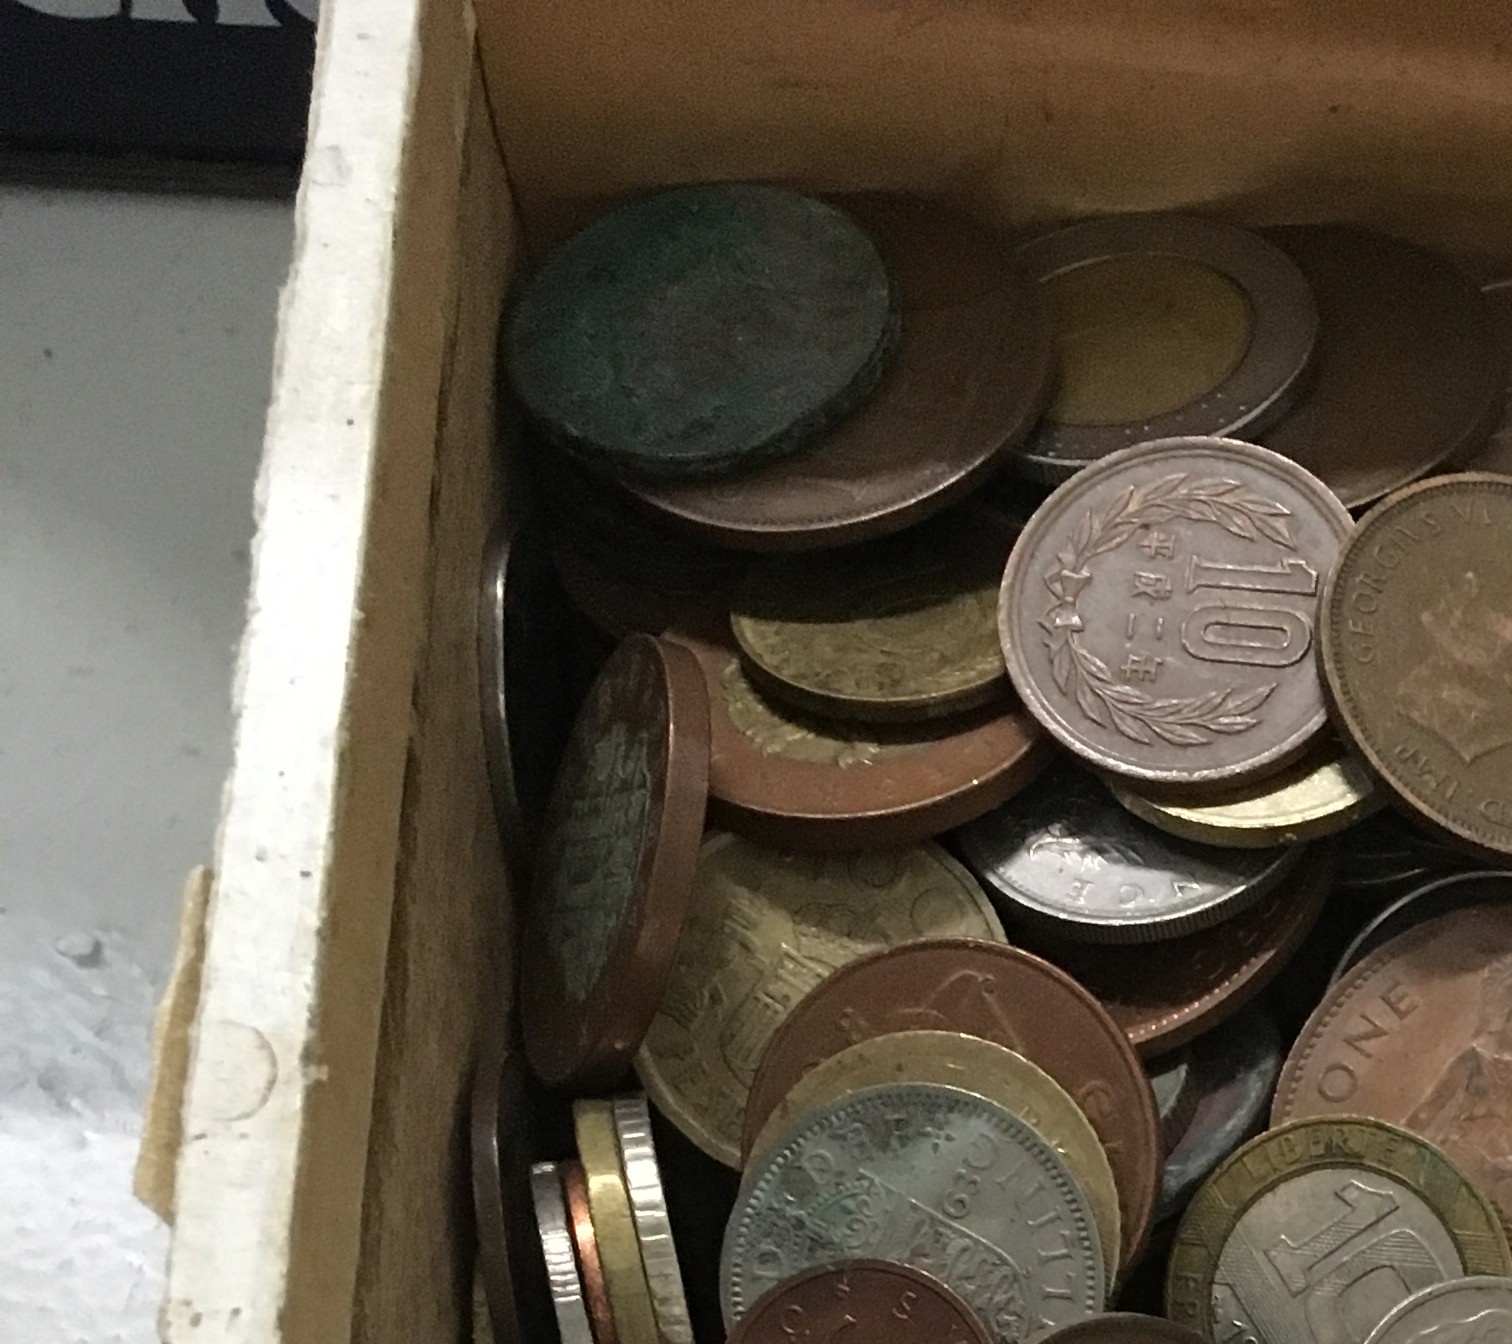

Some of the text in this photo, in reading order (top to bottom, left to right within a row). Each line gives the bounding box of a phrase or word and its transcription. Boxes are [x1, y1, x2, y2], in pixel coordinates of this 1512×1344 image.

[1120, 529, 1178, 683] 平成二年
[1181, 555, 1318, 669] 10
[1317, 981, 1420, 1103] ONE
